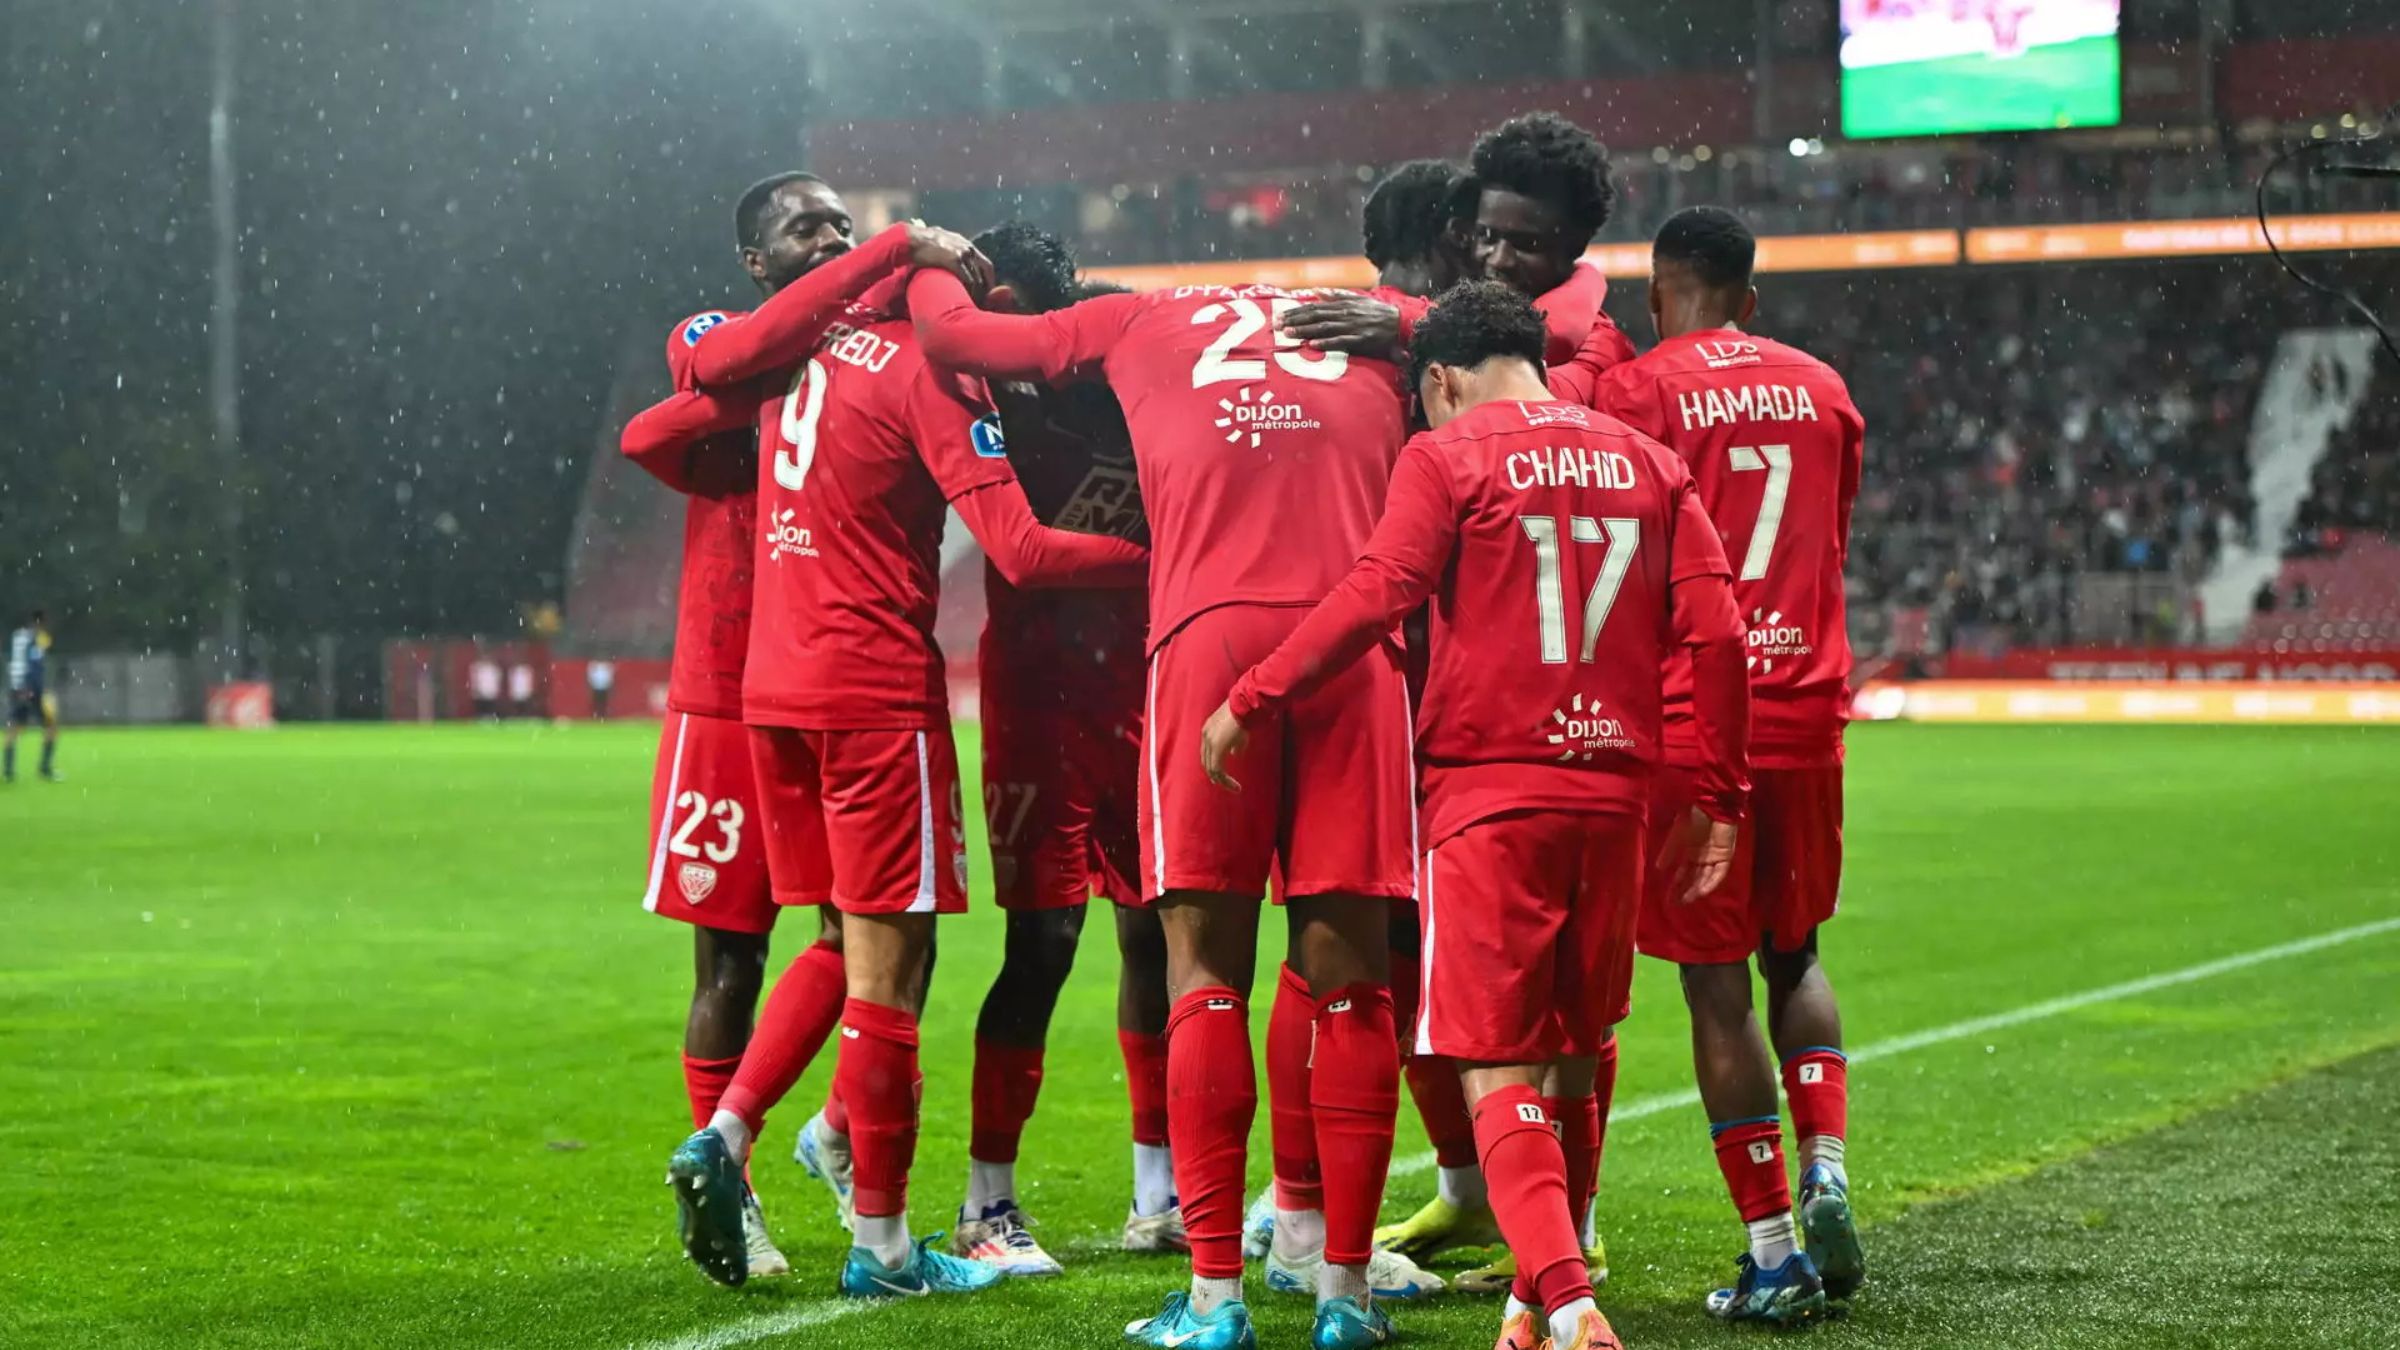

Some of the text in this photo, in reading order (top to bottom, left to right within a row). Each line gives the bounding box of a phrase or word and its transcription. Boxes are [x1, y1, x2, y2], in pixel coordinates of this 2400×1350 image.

[1191, 299, 1349, 389] 25
[774, 358, 827, 490] 9
[1252, 418, 1321, 430] métropole
[1678, 384, 1818, 431] HAMADA
[1506, 446, 1635, 490] CHAHID
[1728, 444, 1792, 581] 7
[1518, 514, 1640, 664] 17
[669, 791, 745, 864] 23
[1806, 1066, 1815, 1080] 7
[1522, 1106, 1539, 1120] 17
[1755, 1145, 1764, 1159] 7
